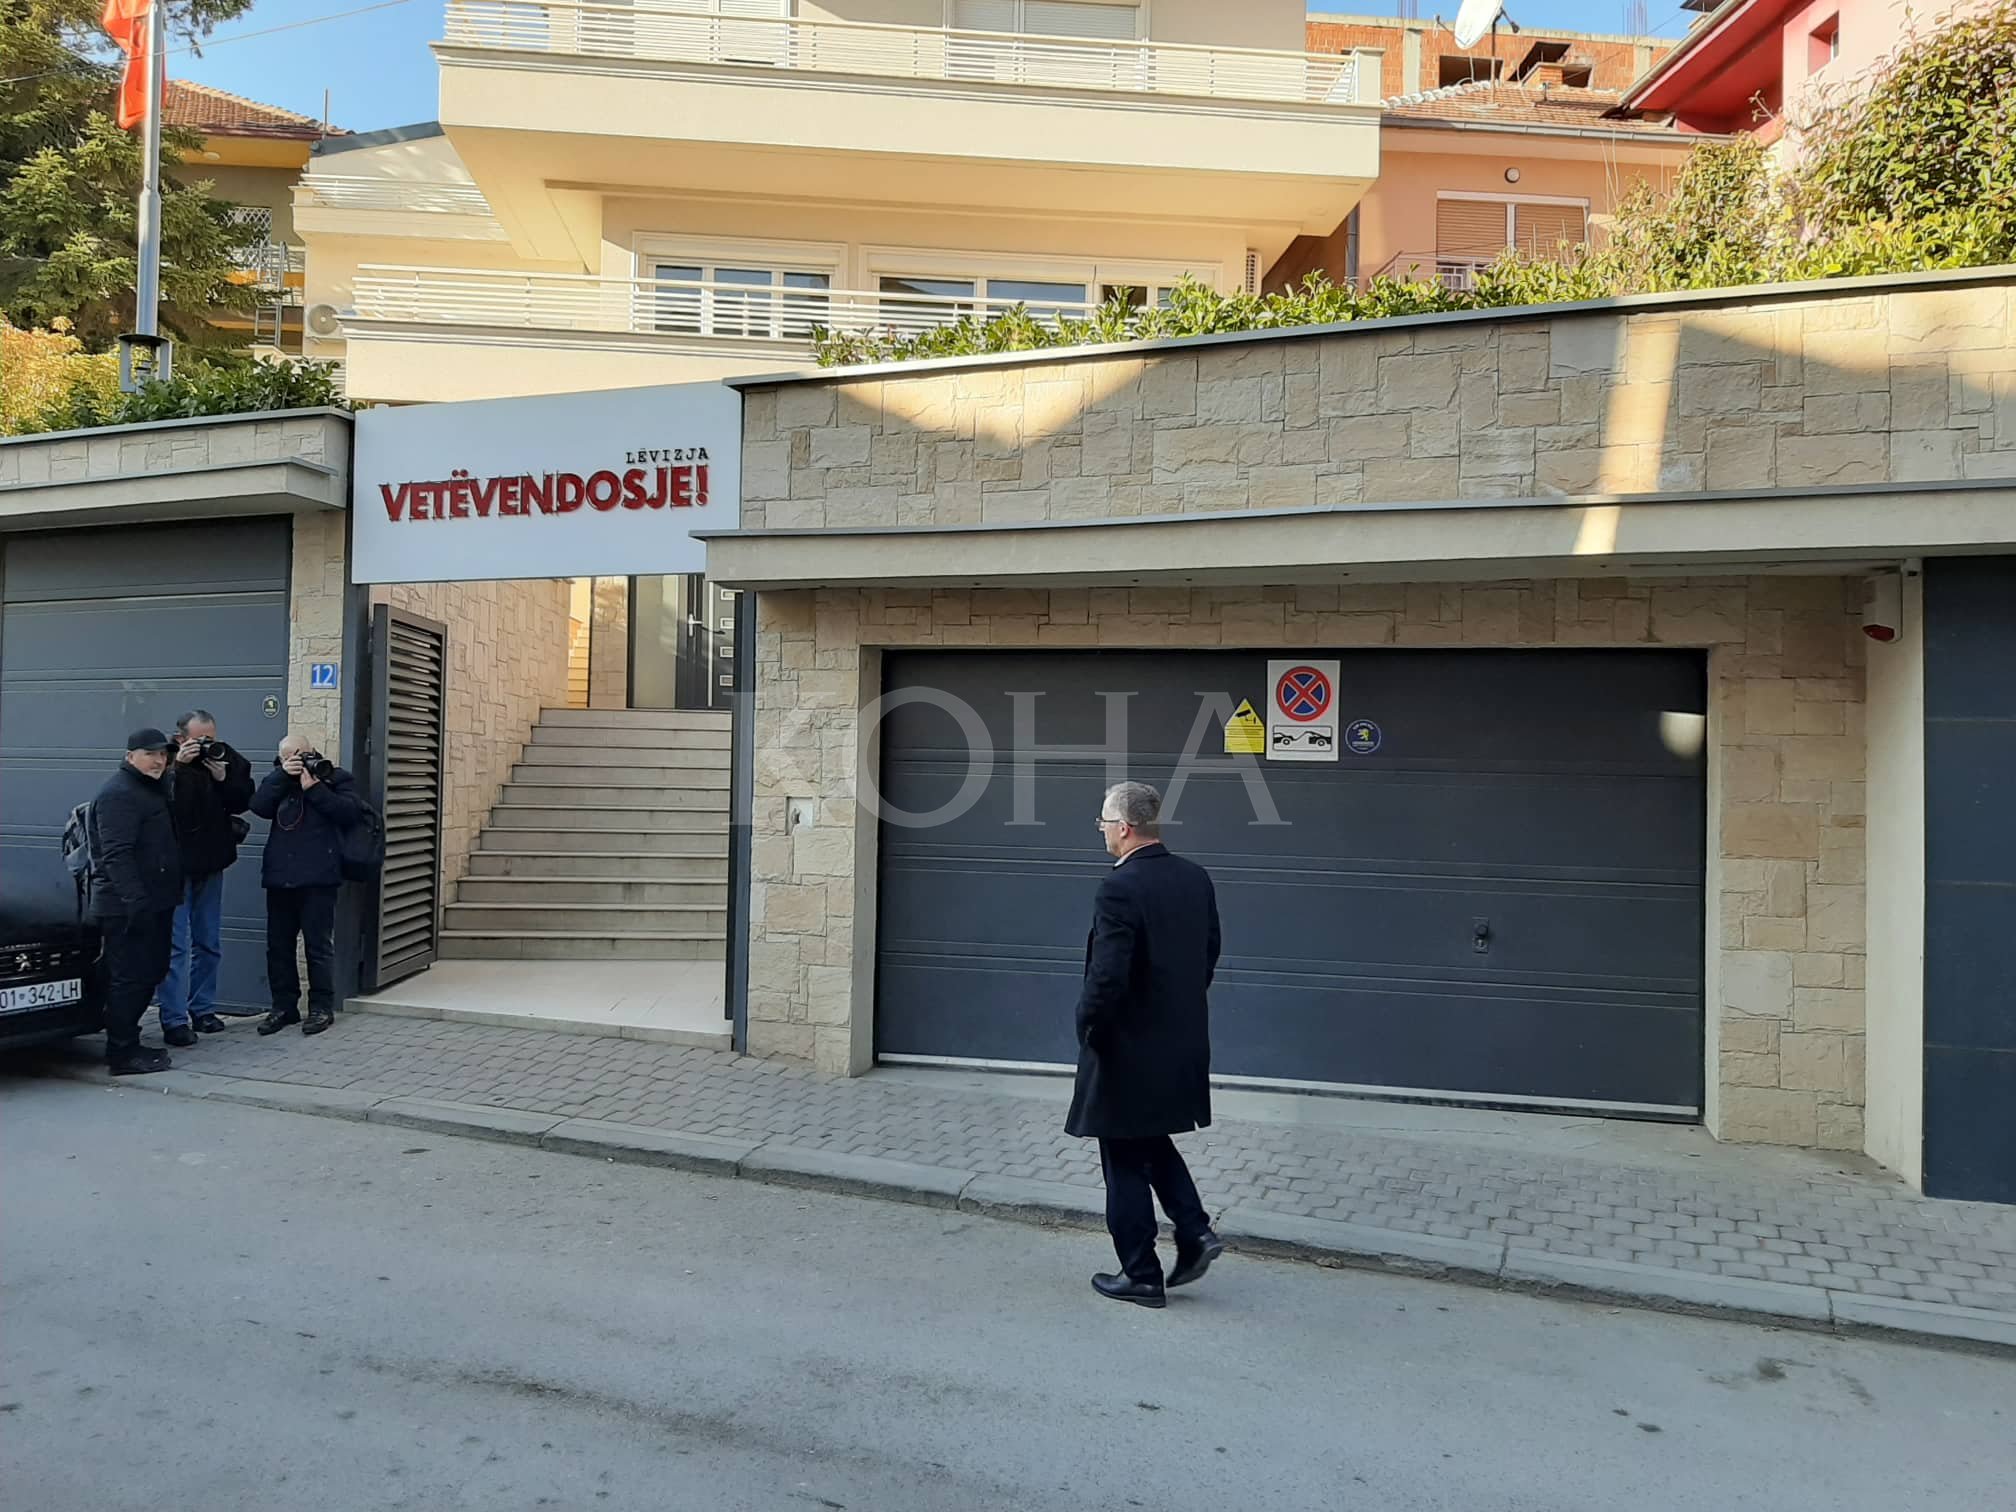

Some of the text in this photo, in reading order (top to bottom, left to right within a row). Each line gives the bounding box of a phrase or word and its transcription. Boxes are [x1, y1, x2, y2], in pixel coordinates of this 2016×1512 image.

[626, 447, 710, 464] LËVIZJA
[378, 464, 710, 522] VETËVENDOSJE!
[312, 664, 333, 686] 12
